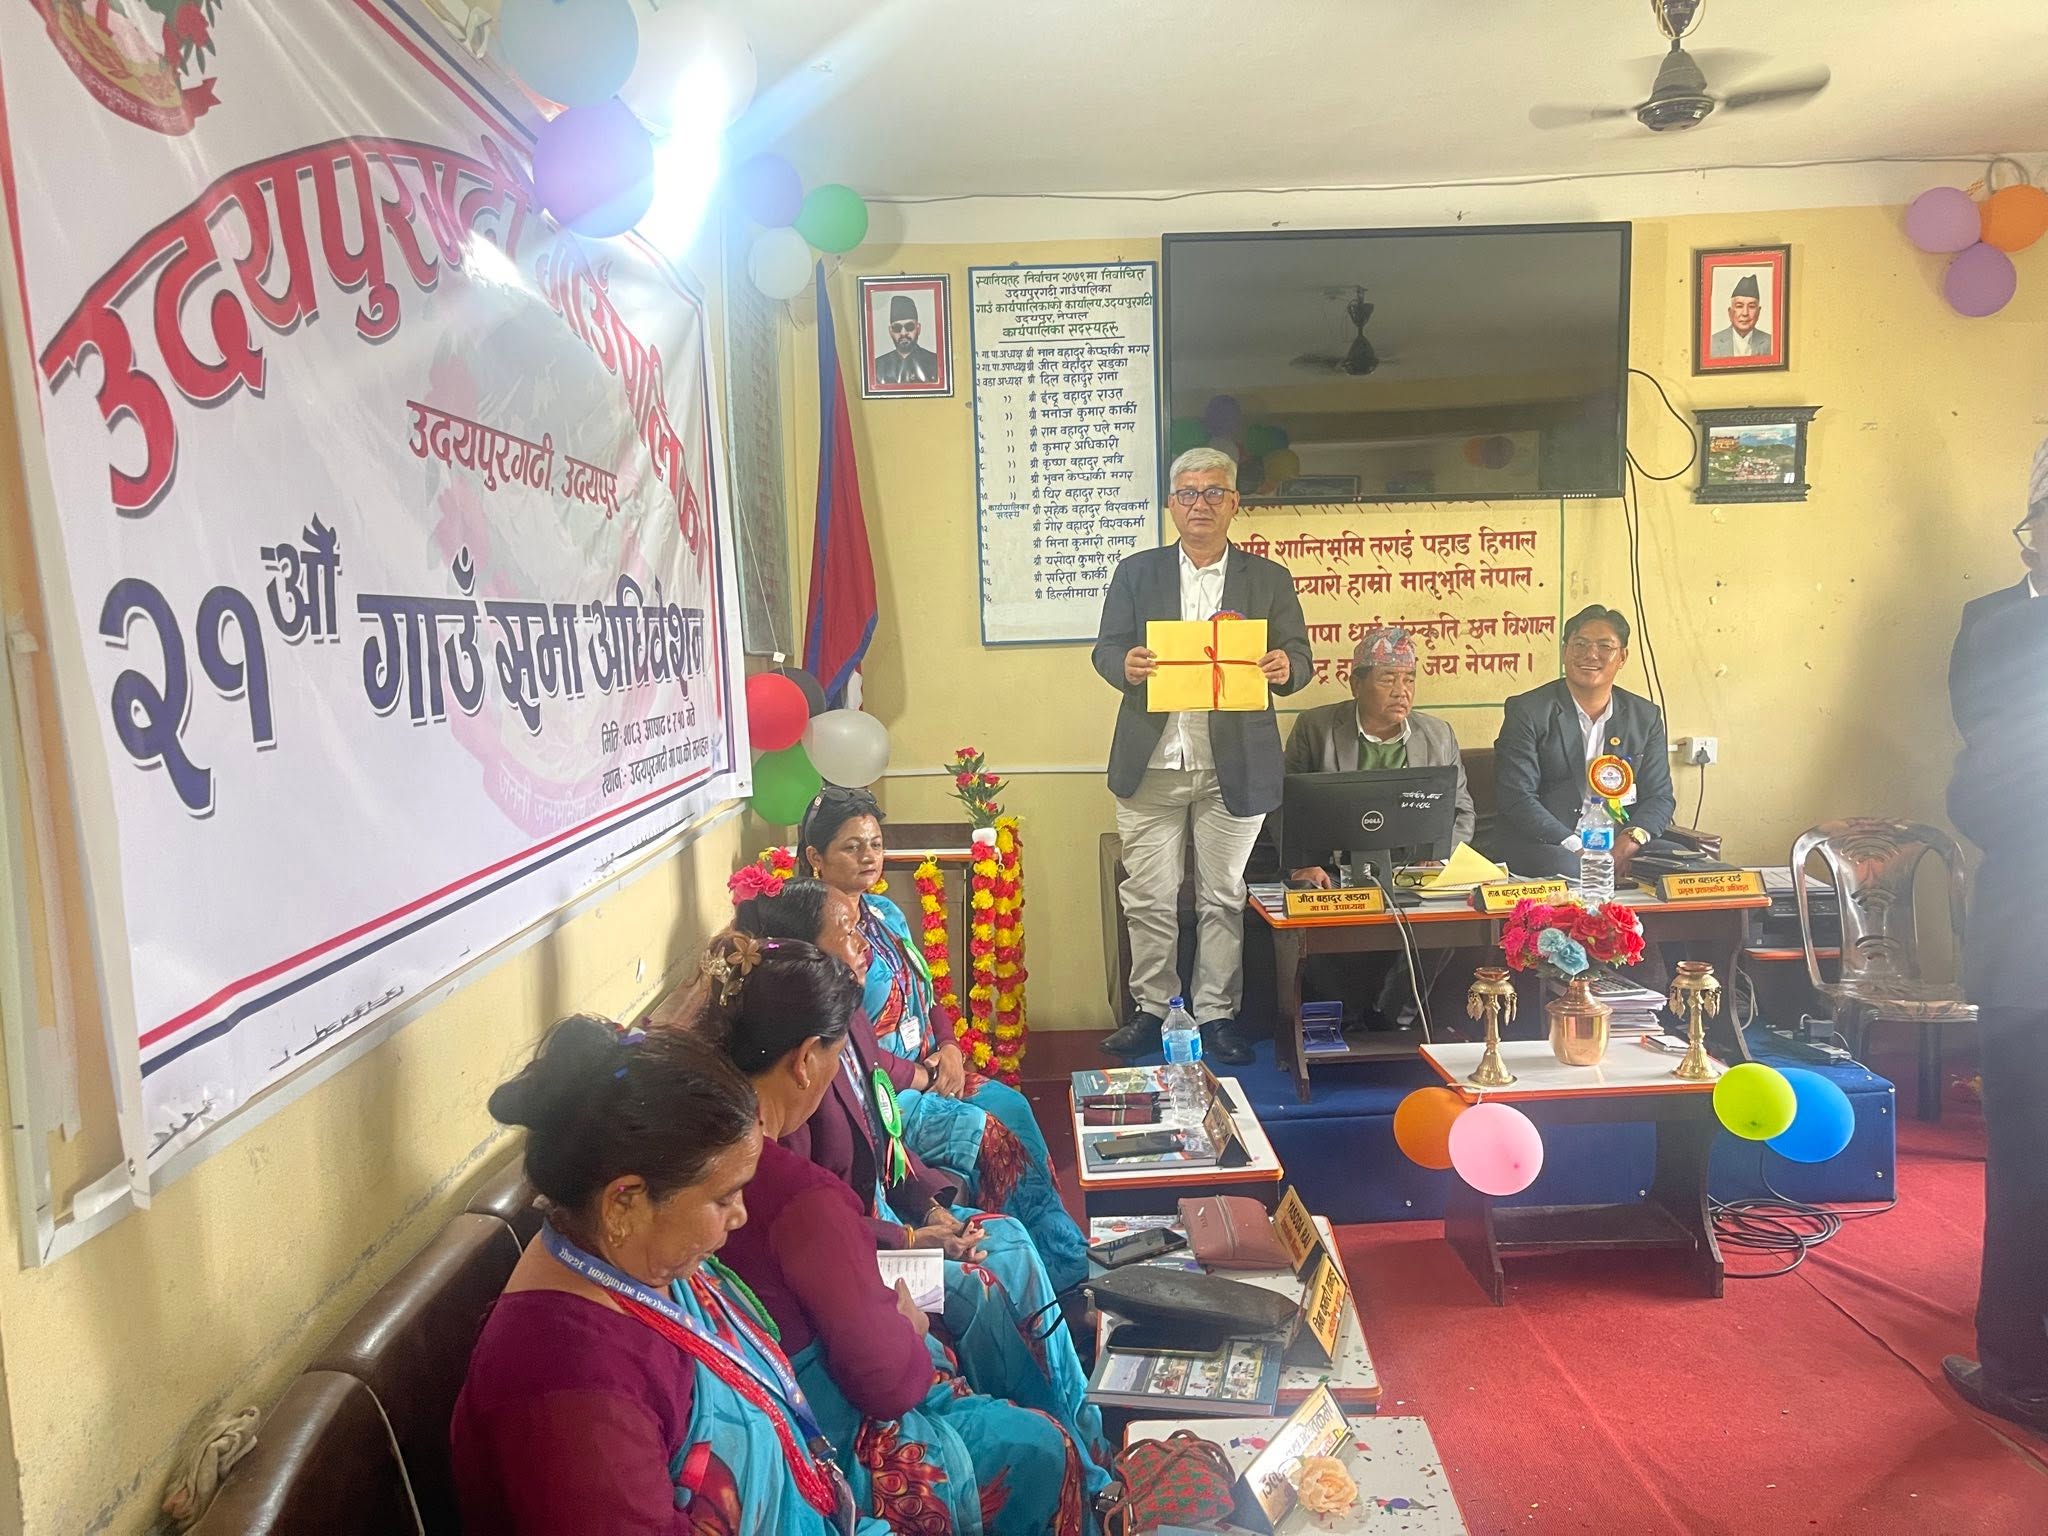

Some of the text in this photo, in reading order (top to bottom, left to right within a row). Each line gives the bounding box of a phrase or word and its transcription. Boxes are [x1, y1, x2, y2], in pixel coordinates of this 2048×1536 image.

[1023, 271, 1060, 283] निर्वाचन
[1101, 266, 1147, 281] निर्वाचित
[1057, 310, 1089, 321] नेपाल
[1002, 322, 1065, 337] कार्यपालिका
[1127, 344, 1150, 357] मगर
[1038, 358, 1059, 372] जीत
[1040, 371, 1060, 387] दिल
[1096, 388, 1123, 401] राउत
[1040, 405, 1073, 418] मनोज
[1077, 406, 1105, 422] कुमार
[1109, 400, 1138, 415] कार्की
[1041, 426, 1058, 438] राम
[1113, 421, 1136, 432] मगर
[1042, 441, 1071, 456] कुमार
[1075, 434, 1120, 450] अधिकारी
[1042, 458, 1067, 471] कृष्ण
[1110, 471, 1133, 481] मगर
[561, 453, 621, 520] उदयपुर
[1096, 487, 1121, 499] राउत
[1045, 535, 1069, 548] मिना
[1072, 533, 1104, 551] कुमारी
[1275, 530, 1365, 566] शान्तिभूमि
[1369, 529, 1414, 565] तराई
[1420, 533, 1472, 564] पहाड
[1478, 526, 1537, 562] हिमाल
[1078, 551, 1105, 568] कुमारी
[1045, 568, 1076, 584] सरिता
[1081, 566, 1108, 580] कार्की
[1347, 565, 1392, 605] हाम्रो
[1502, 611, 1556, 643] विशाल
[586, 573, 705, 702] अधिवेशन
[1422, 655, 1460, 676] जय
[1465, 644, 1521, 681] नेपाल
